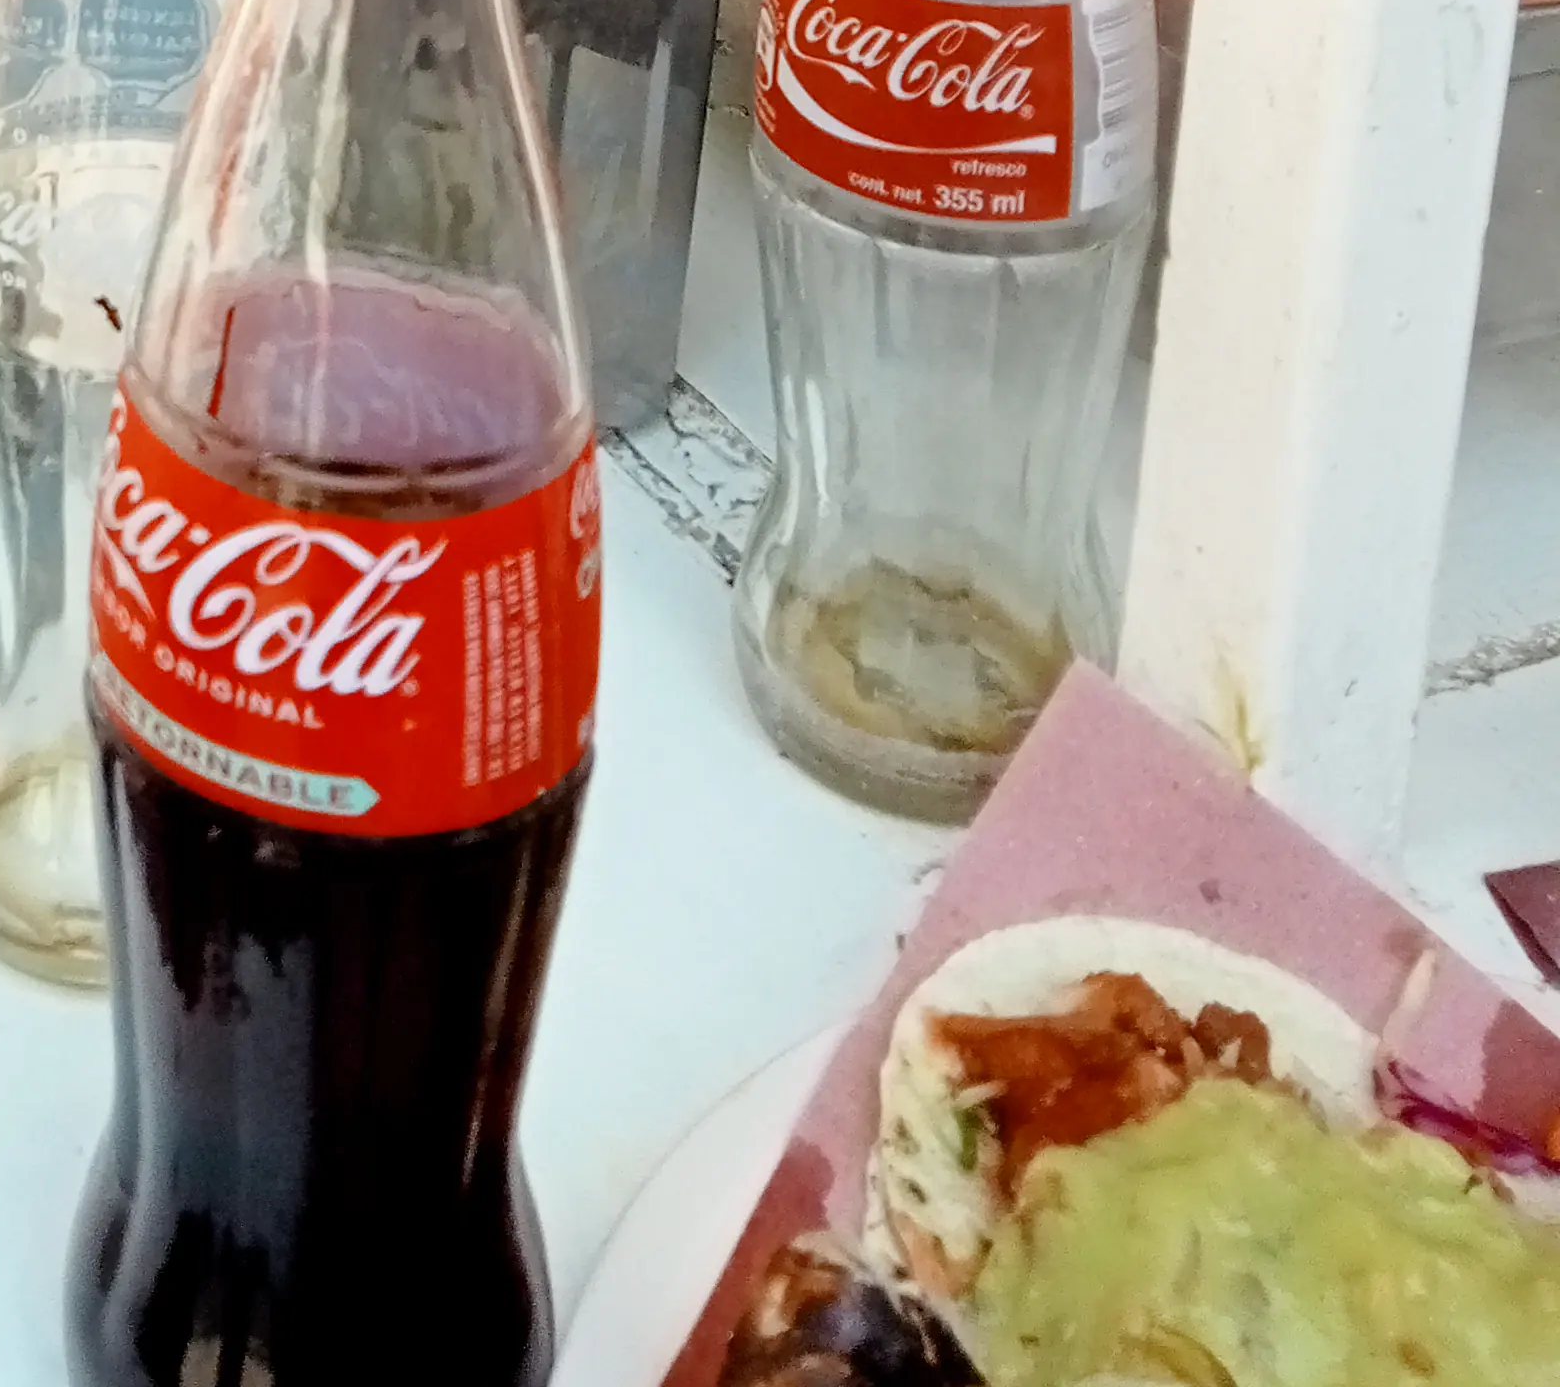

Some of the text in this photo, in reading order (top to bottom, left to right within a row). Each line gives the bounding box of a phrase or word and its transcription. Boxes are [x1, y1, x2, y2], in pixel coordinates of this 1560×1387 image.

[951, 158, 1027, 177] refresco
[933, 183, 984, 213] 355
[991, 189, 1026, 215] ml
[153, 641, 325, 730] ORIGINAL
